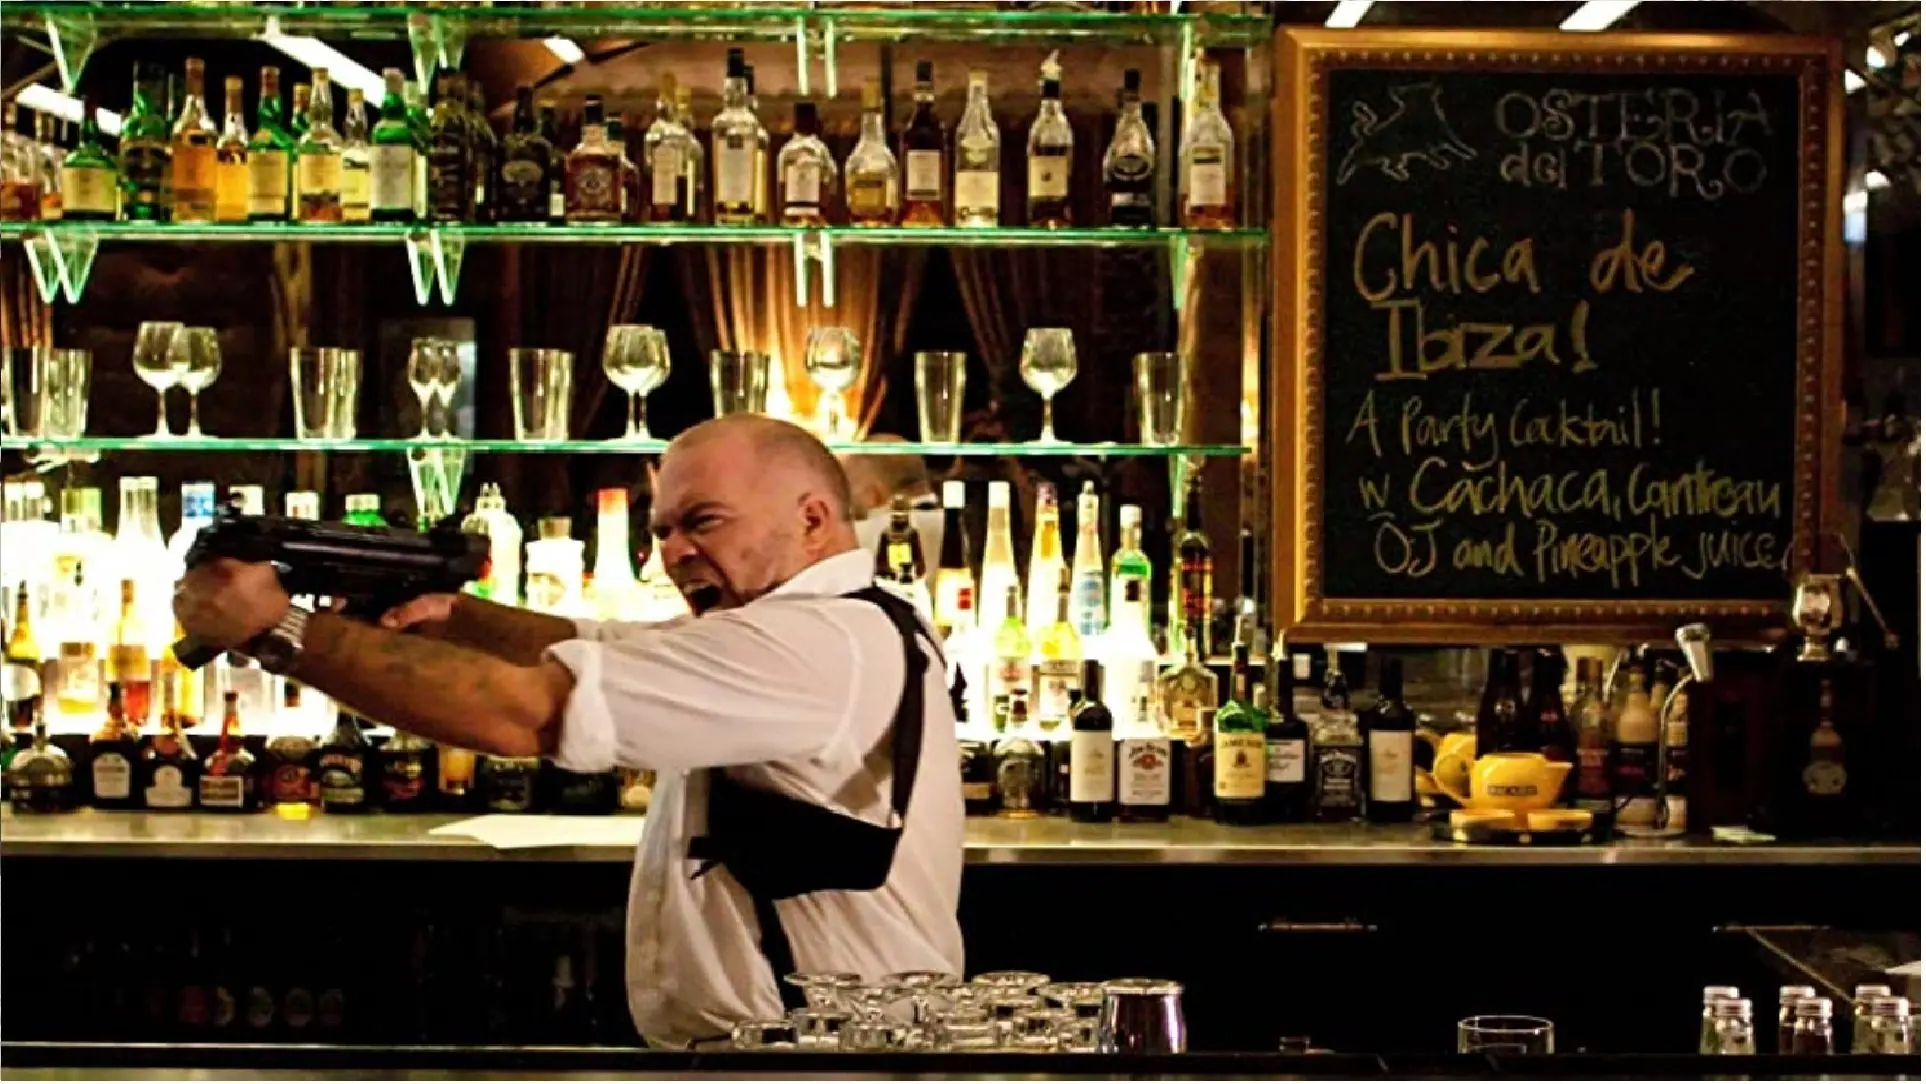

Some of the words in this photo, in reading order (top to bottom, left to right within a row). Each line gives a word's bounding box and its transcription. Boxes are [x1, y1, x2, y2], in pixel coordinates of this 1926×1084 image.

[1495, 88, 1776, 146] OSTERIA
[1575, 140, 1768, 199] TORO
[1353, 212, 1541, 302] Chica
[1590, 208, 1695, 294] de
[1370, 299, 1598, 381] Ibiza!
[1347, 390, 1382, 456] A
[1402, 393, 1502, 470] Party
[1452, 521, 1521, 576] and
[1532, 513, 1681, 589] Pineapple
